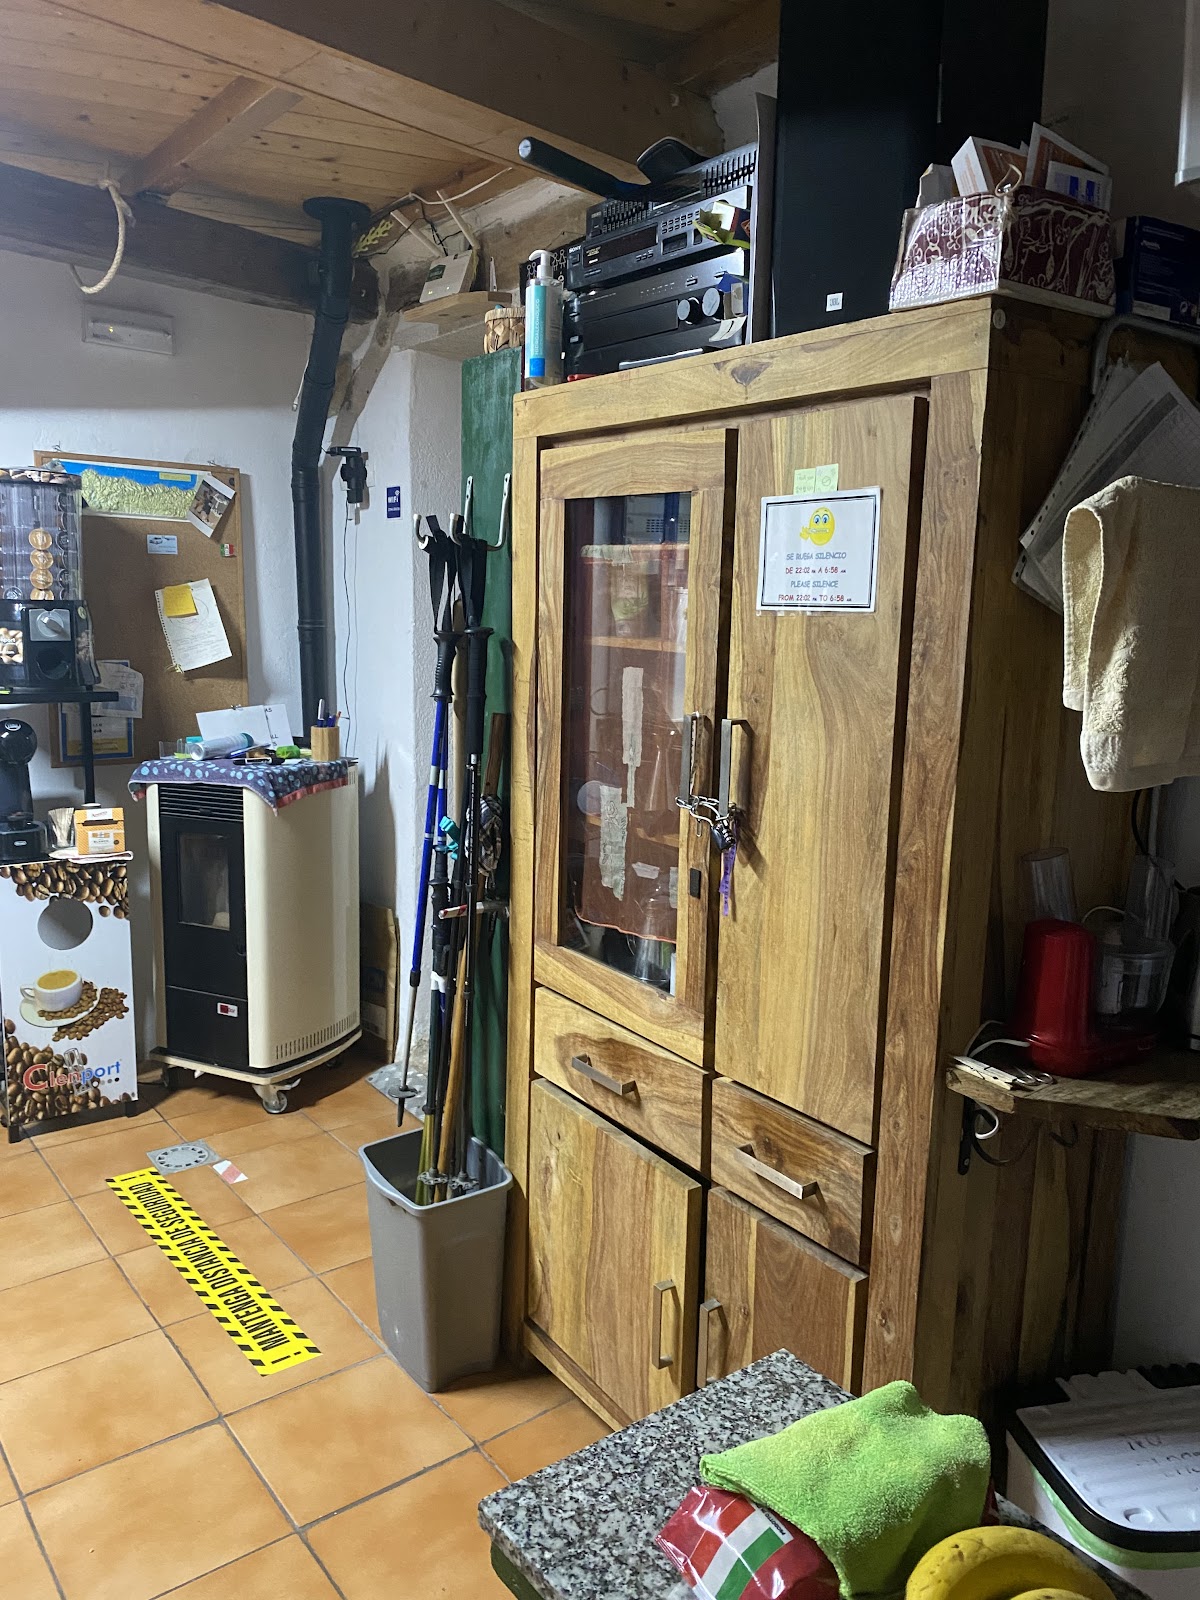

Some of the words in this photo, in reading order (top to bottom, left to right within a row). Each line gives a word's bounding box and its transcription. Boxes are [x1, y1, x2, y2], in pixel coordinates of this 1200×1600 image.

[568, 245, 581, 253] SONY
[796, 552, 813, 560] RUEGA
[815, 551, 847, 560] SILENCIO
[785, 566, 794, 574] DE
[795, 566, 810, 574] 22:02
[824, 566, 839, 574] 6:58
[790, 580, 811, 588] PLEASE
[812, 580, 839, 588] SILENCE
[778, 594, 794, 602] FROM
[796, 594, 811, 602] 22:02
[819, 594, 828, 602] TO
[829, 594, 844, 602] 6:58
[128, 1181, 186, 1230] SEGURIDAD
[165, 1224, 196, 1242] DE
[176, 1236, 238, 1290] DISTANCIA
[217, 1285, 291, 1352] MANTENGA
